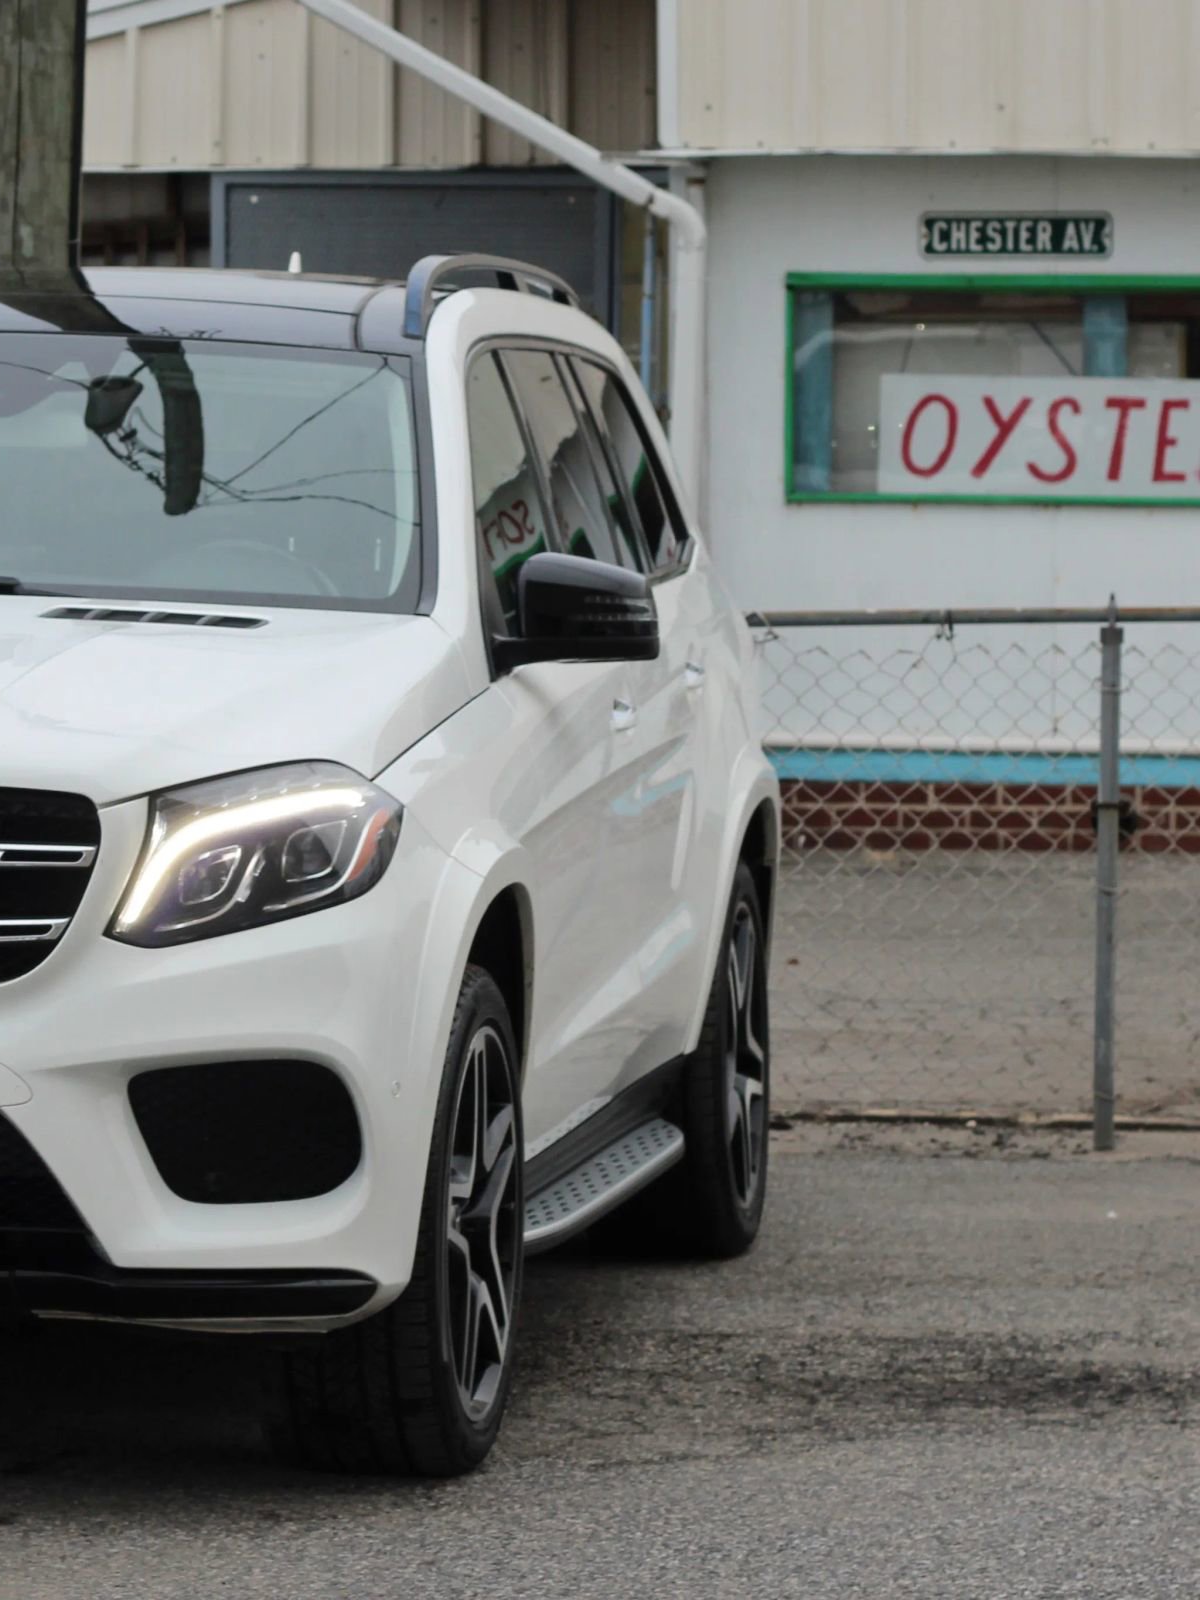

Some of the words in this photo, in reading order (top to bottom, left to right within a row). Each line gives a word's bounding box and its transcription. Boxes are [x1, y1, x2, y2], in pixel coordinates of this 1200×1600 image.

[931, 220, 1052, 252] CHESTER
[1062, 220, 1099, 252] AV.
[901, 393, 1200, 484] OYSTE
